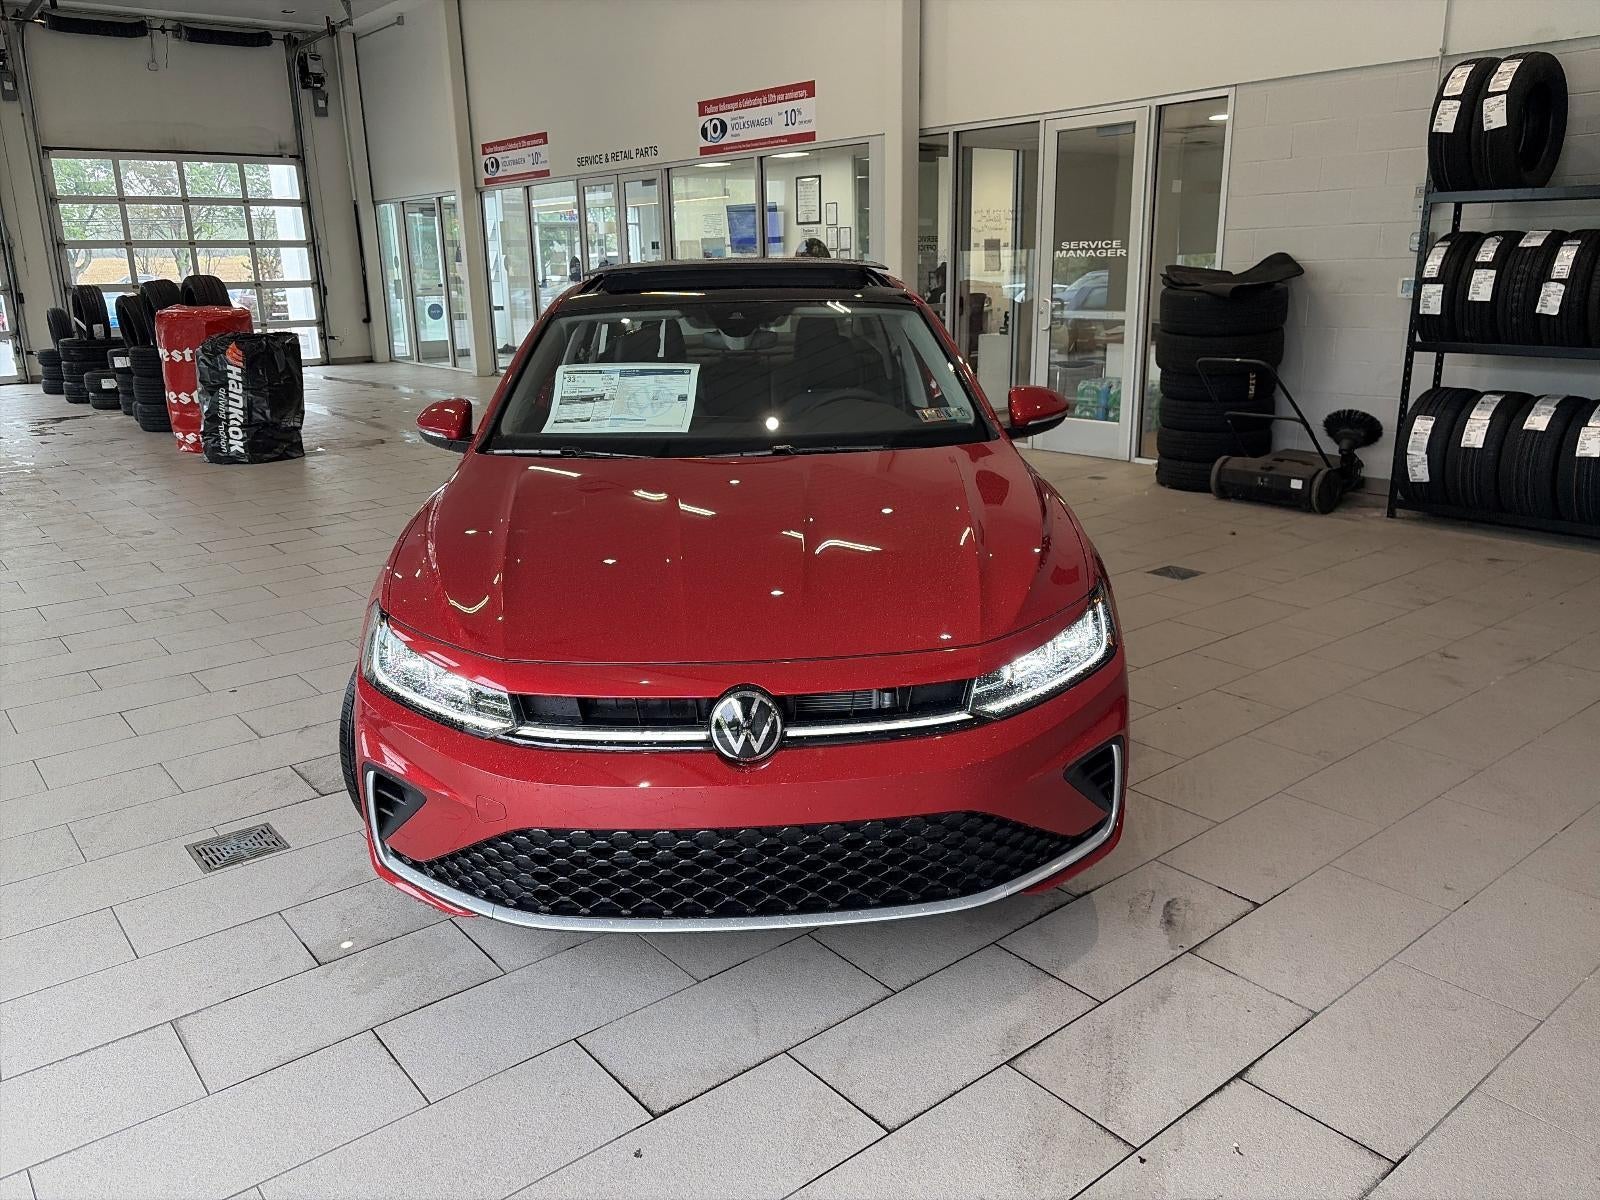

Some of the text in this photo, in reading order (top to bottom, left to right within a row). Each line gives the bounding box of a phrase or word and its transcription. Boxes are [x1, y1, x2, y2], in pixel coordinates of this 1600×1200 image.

[730, 117, 773, 131] VOLKSWAGEN
[576, 145, 659, 167] SERVICE & RETAIL PARTS
[1061, 240, 1122, 250] SERVICE
[1055, 249, 1127, 258] MANAGER
[159, 347, 194, 362] est
[166, 389, 200, 405] est
